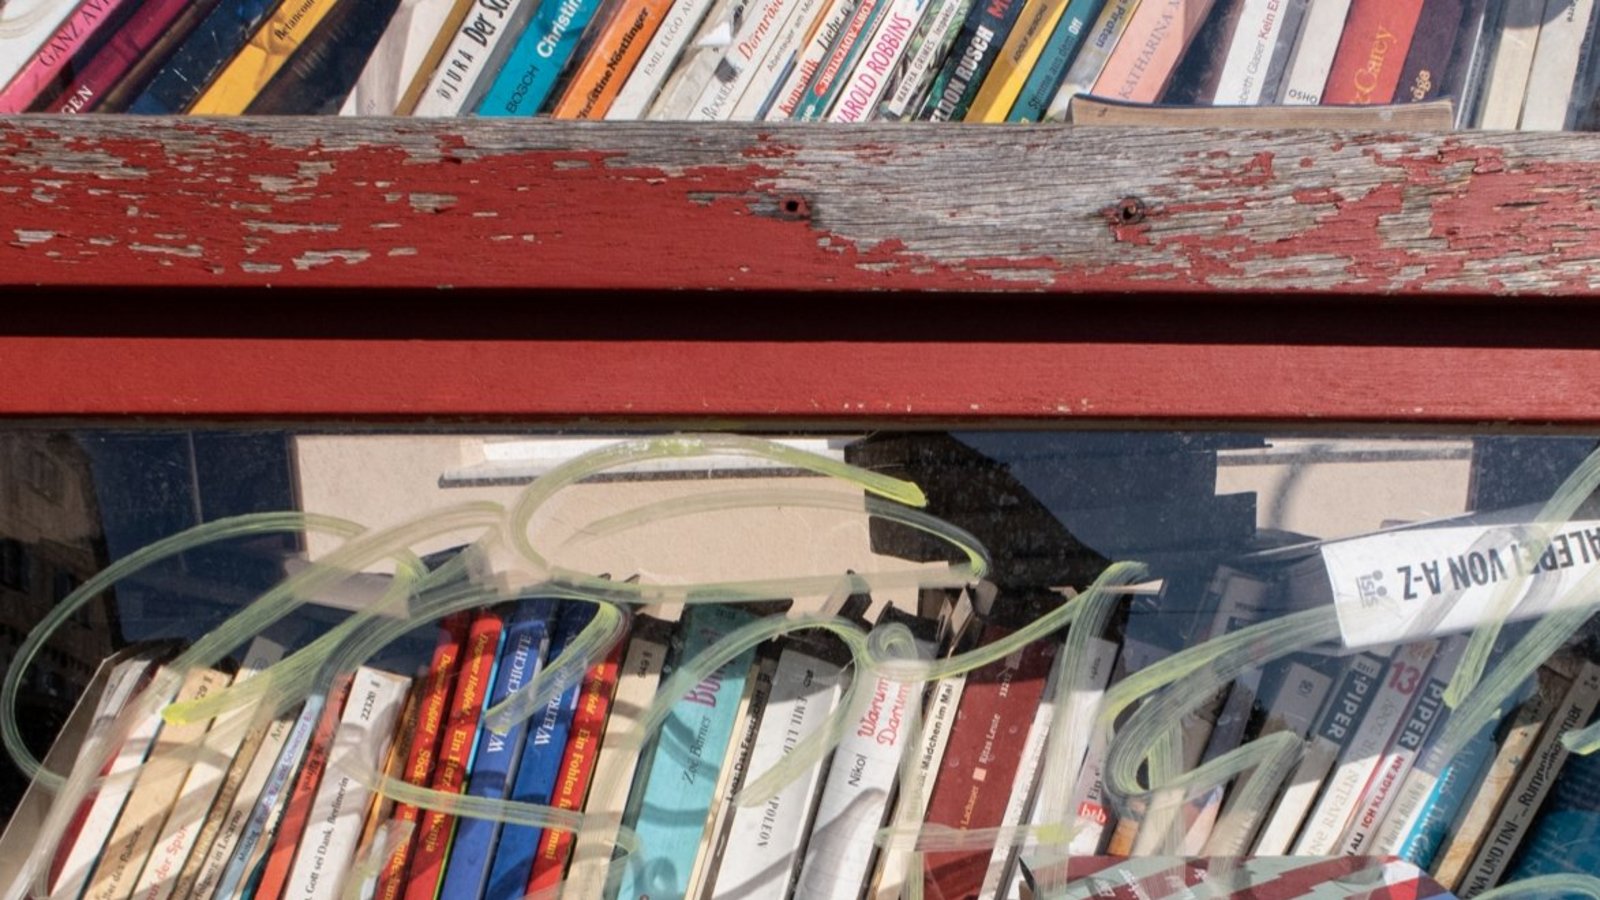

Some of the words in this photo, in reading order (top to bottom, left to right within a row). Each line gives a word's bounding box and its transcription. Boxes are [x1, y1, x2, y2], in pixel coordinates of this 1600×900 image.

[38, 20, 80, 67] GANZ
[463, 12, 496, 47] Der
[644, 48, 665, 77] EMIL
[661, 17, 684, 48] LUGO
[767, 30, 796, 72] Abenteuer
[867, 12, 912, 77] ROBBINS
[955, 25, 994, 81] RUSCH
[1011, 36, 1030, 65] ADOLF
[1050, 54, 1064, 77] aus
[1058, 33, 1076, 58] dem
[1067, 16, 1084, 36] Off
[1097, 7, 1125, 49] Piraten
[1247, 42, 1267, 76] Glaser
[1258, 13, 1275, 41] Kein
[576, 69, 612, 120] hristine
[609, 6, 649, 73] Nöstlinger
[779, 58, 820, 117] Konsalik
[816, 19, 841, 51] Liebe
[898, 69, 919, 103] MARTHA
[915, 39, 936, 72] GRIMES
[1119, 13, 1174, 100] KATHARINA
[1354, 25, 1398, 92] Carey
[505, 64, 539, 115] BOSCH
[1288, 89, 1319, 105] OSHO
[1396, 559, 1441, 601] A-Z
[1446, 548, 1509, 591] VON
[360, 690, 377, 722] 22320
[741, 689, 767, 752] Feuerschiff
[789, 695, 809, 728] EMIL
[857, 676, 889, 738] Warum
[984, 712, 1002, 742] Leute
[1328, 675, 1369, 739] PIPER
[1399, 682, 1446, 750] PIPER
[450, 728, 467, 752] Ein
[574, 728, 591, 749] Ein
[688, 715, 713, 757] Barnes
[920, 721, 943, 773] Mädchen
[977, 740, 996, 764] Ritas
[441, 753, 460, 787] Herz
[561, 750, 585, 797] Fohlen
[847, 753, 869, 788] Nikol
[757, 796, 780, 848] POLEON
[1351, 831, 1366, 851] ALI
[1361, 808, 1378, 830] ICH
[1371, 771, 1398, 810] KLAGE
[1391, 755, 1406, 774] AN
[155, 854, 173, 882] der
[166, 825, 189, 859] Spur
[219, 809, 244, 854] Locarno
[303, 869, 322, 895] Gott
[317, 825, 336, 857] Dank,
[327, 776, 350, 828] Berlinerin
[424, 811, 445, 853] Wanja
[1479, 846, 1505, 875] UND
[1494, 820, 1519, 846] TINI
